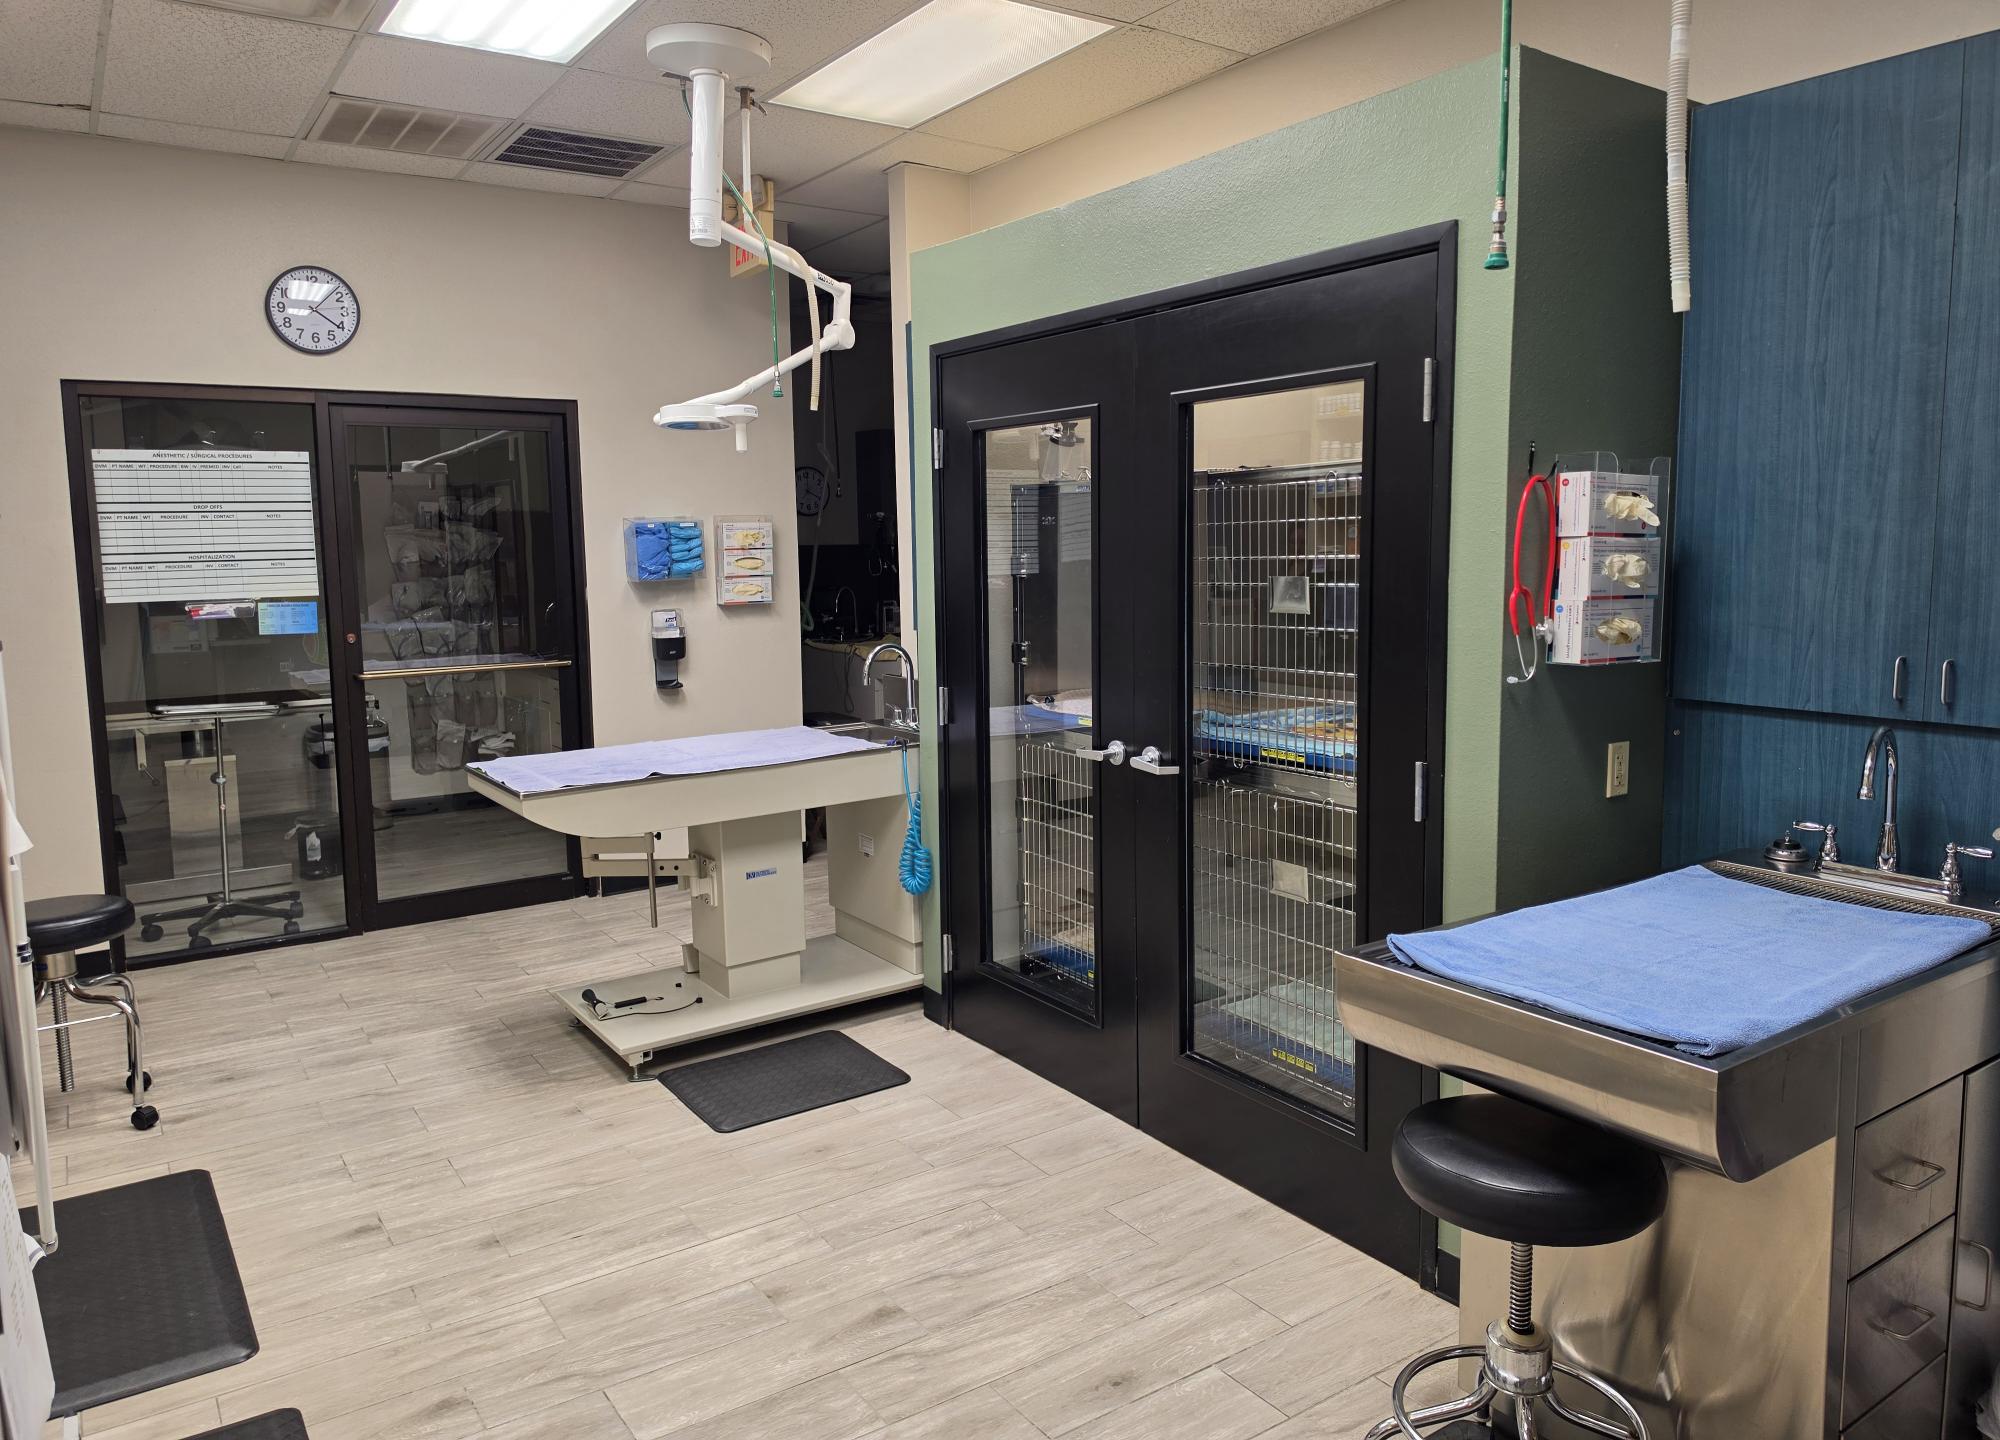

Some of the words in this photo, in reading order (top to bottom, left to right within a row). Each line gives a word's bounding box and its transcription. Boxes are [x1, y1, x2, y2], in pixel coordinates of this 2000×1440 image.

[335, 291, 344, 303] 2
[276, 301, 286, 314] 9
[340, 306, 350, 318] 3
[282, 316, 292, 329] 8
[338, 320, 346, 332] 4
[296, 328, 305, 340] 7
[311, 332, 321, 344] 6
[327, 329, 336, 341] 5
